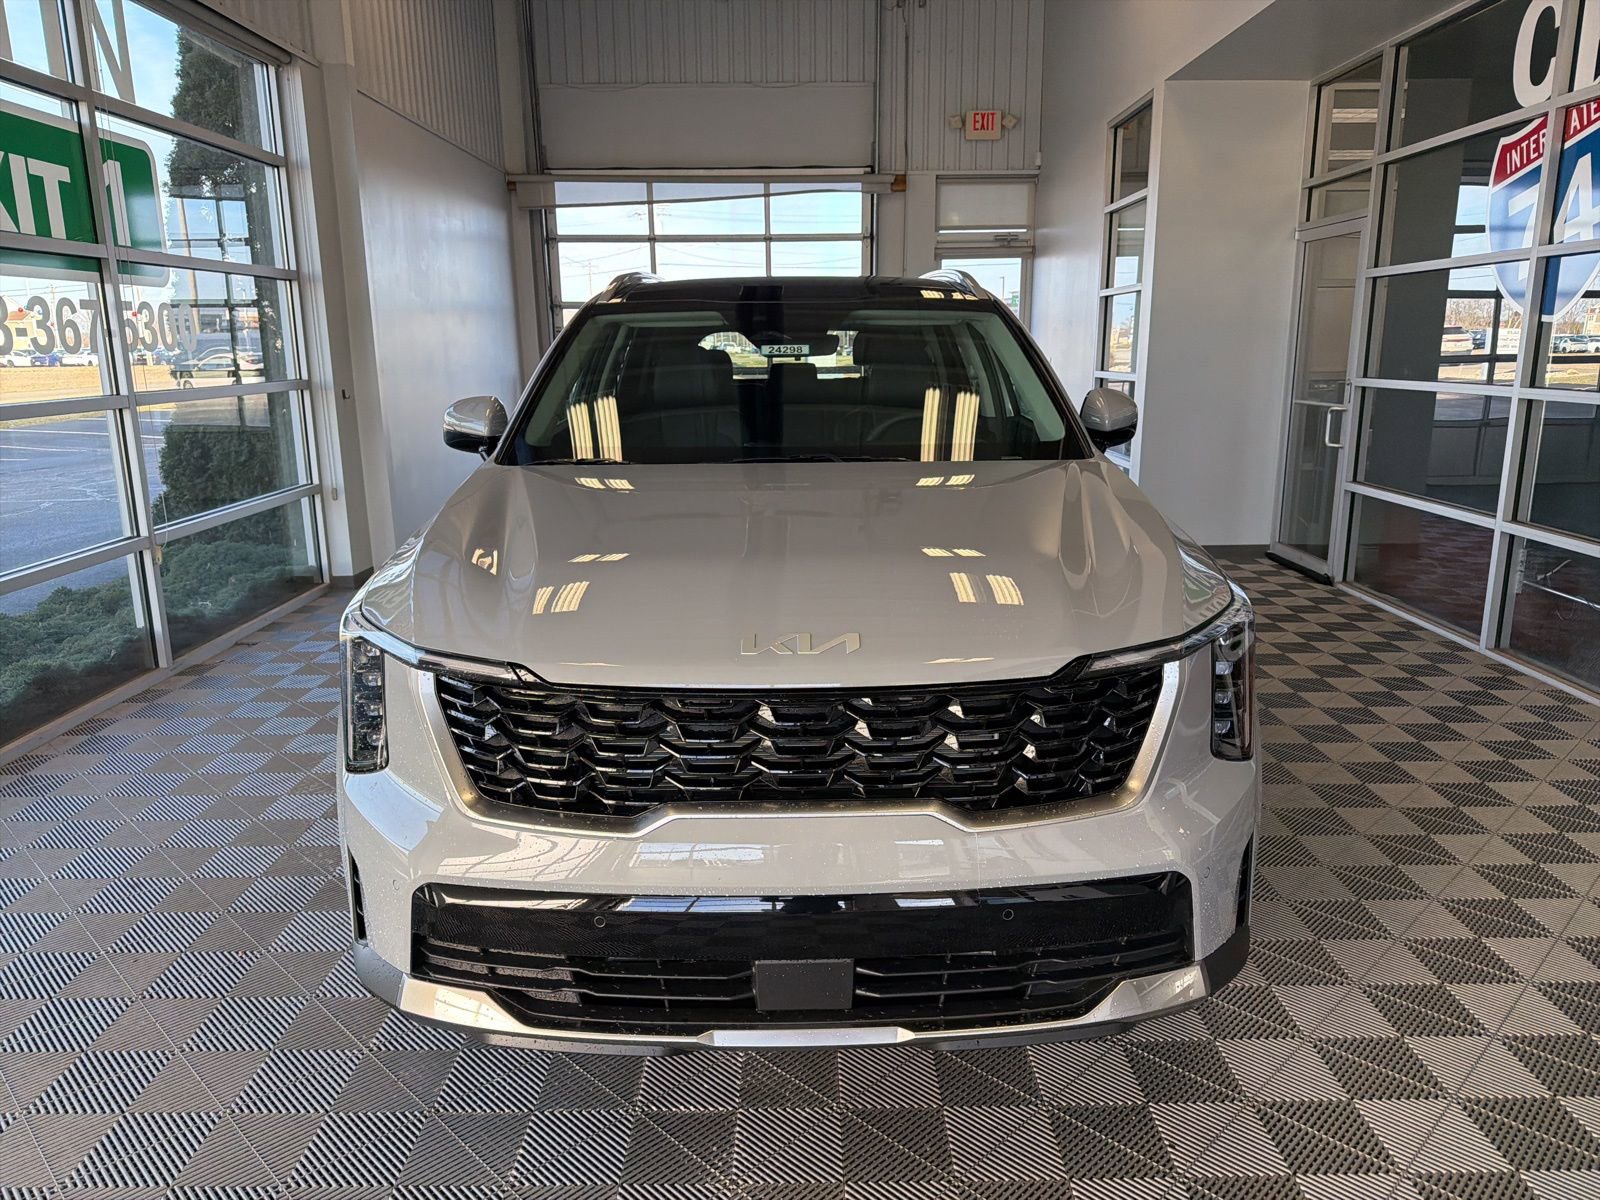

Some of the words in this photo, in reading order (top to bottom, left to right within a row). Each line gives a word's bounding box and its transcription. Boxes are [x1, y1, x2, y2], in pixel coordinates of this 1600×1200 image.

[973, 112, 996, 131] EXIT
[1506, 101, 1600, 175] INTERATE
[768, 346, 803, 354] 24298
[741, 632, 862, 655] KIA
